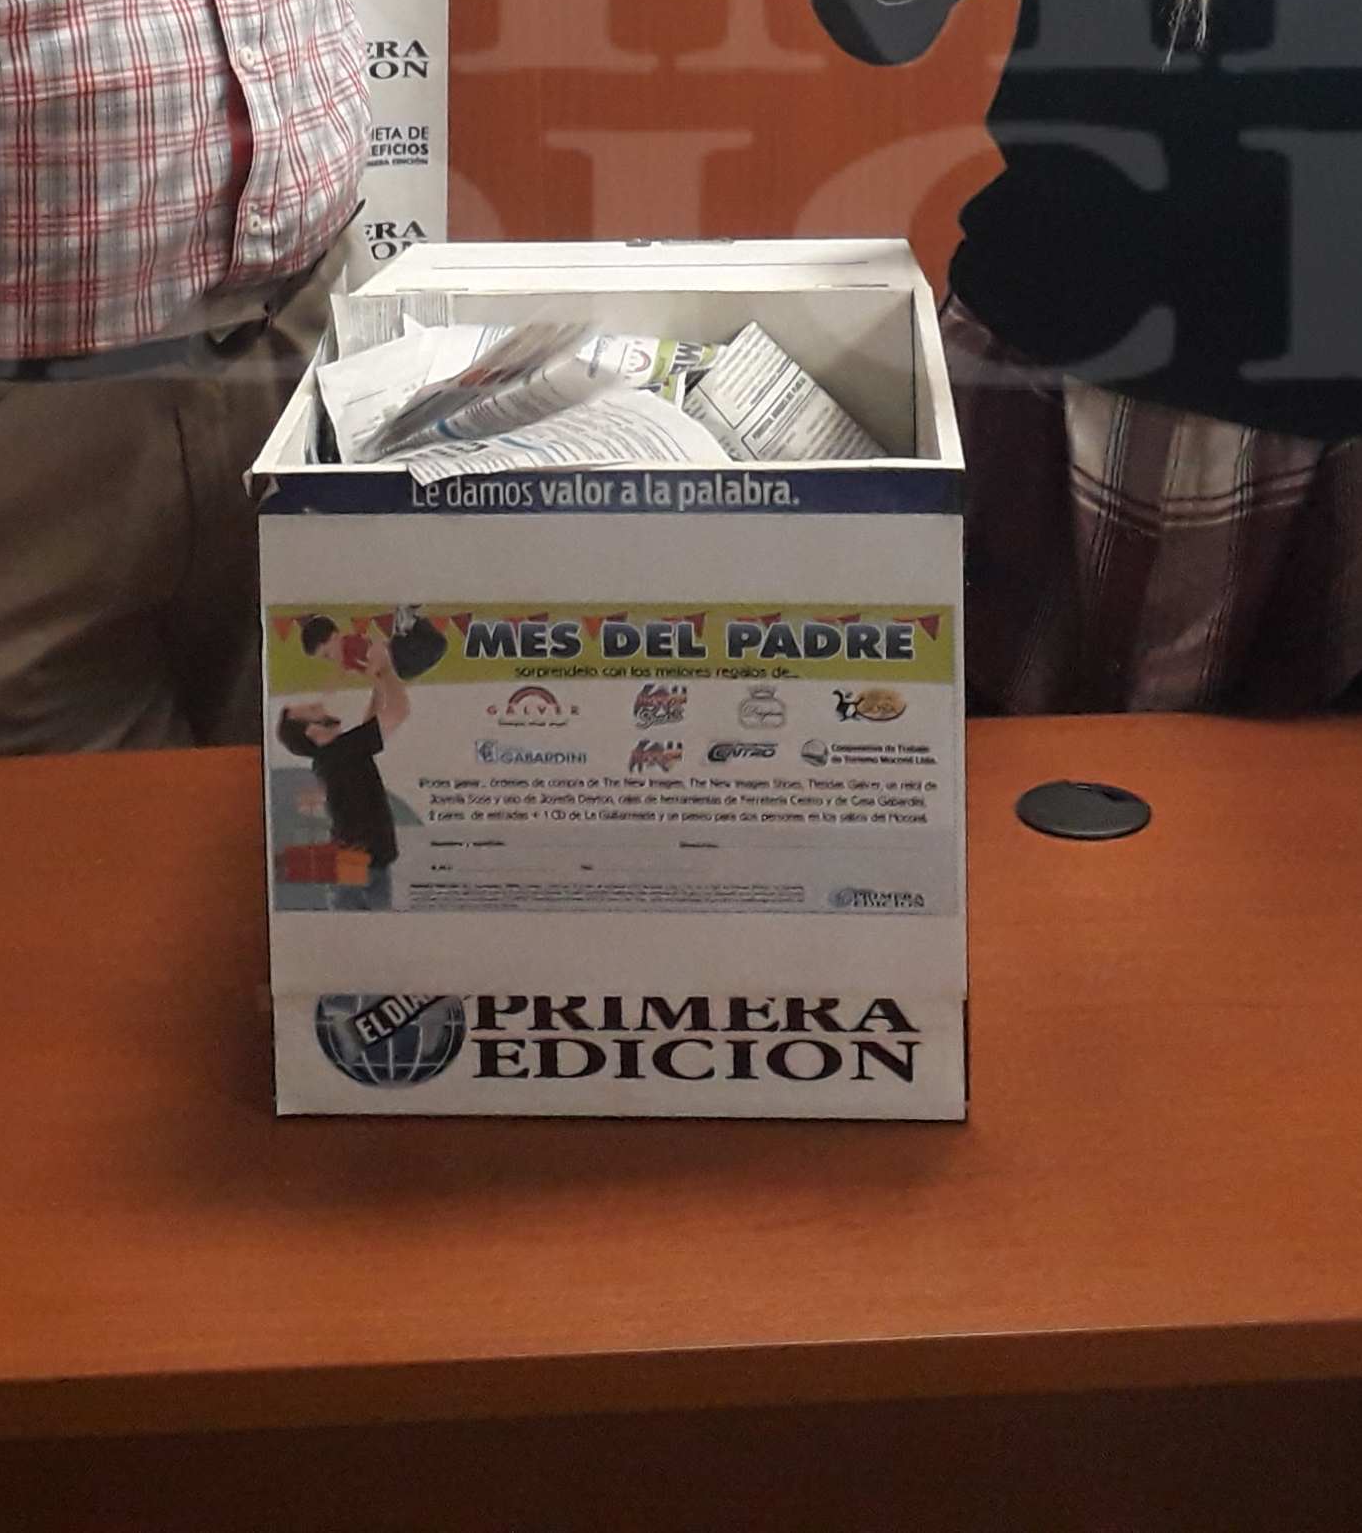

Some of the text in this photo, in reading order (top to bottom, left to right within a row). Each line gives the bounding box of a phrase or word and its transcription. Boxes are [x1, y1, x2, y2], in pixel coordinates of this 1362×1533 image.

[371, 143, 429, 156] EFICIOS
[409, 126, 429, 140] DE
[412, 473, 800, 512] Le damos valor a la palabra.
[464, 621, 915, 661] MES DEL PADRE
[603, 668, 627, 678] con
[631, 666, 651, 678] los
[354, 1010, 394, 1044] EL
[469, 994, 921, 1033] PRIMERA
[471, 1038, 921, 1083] EDICION
